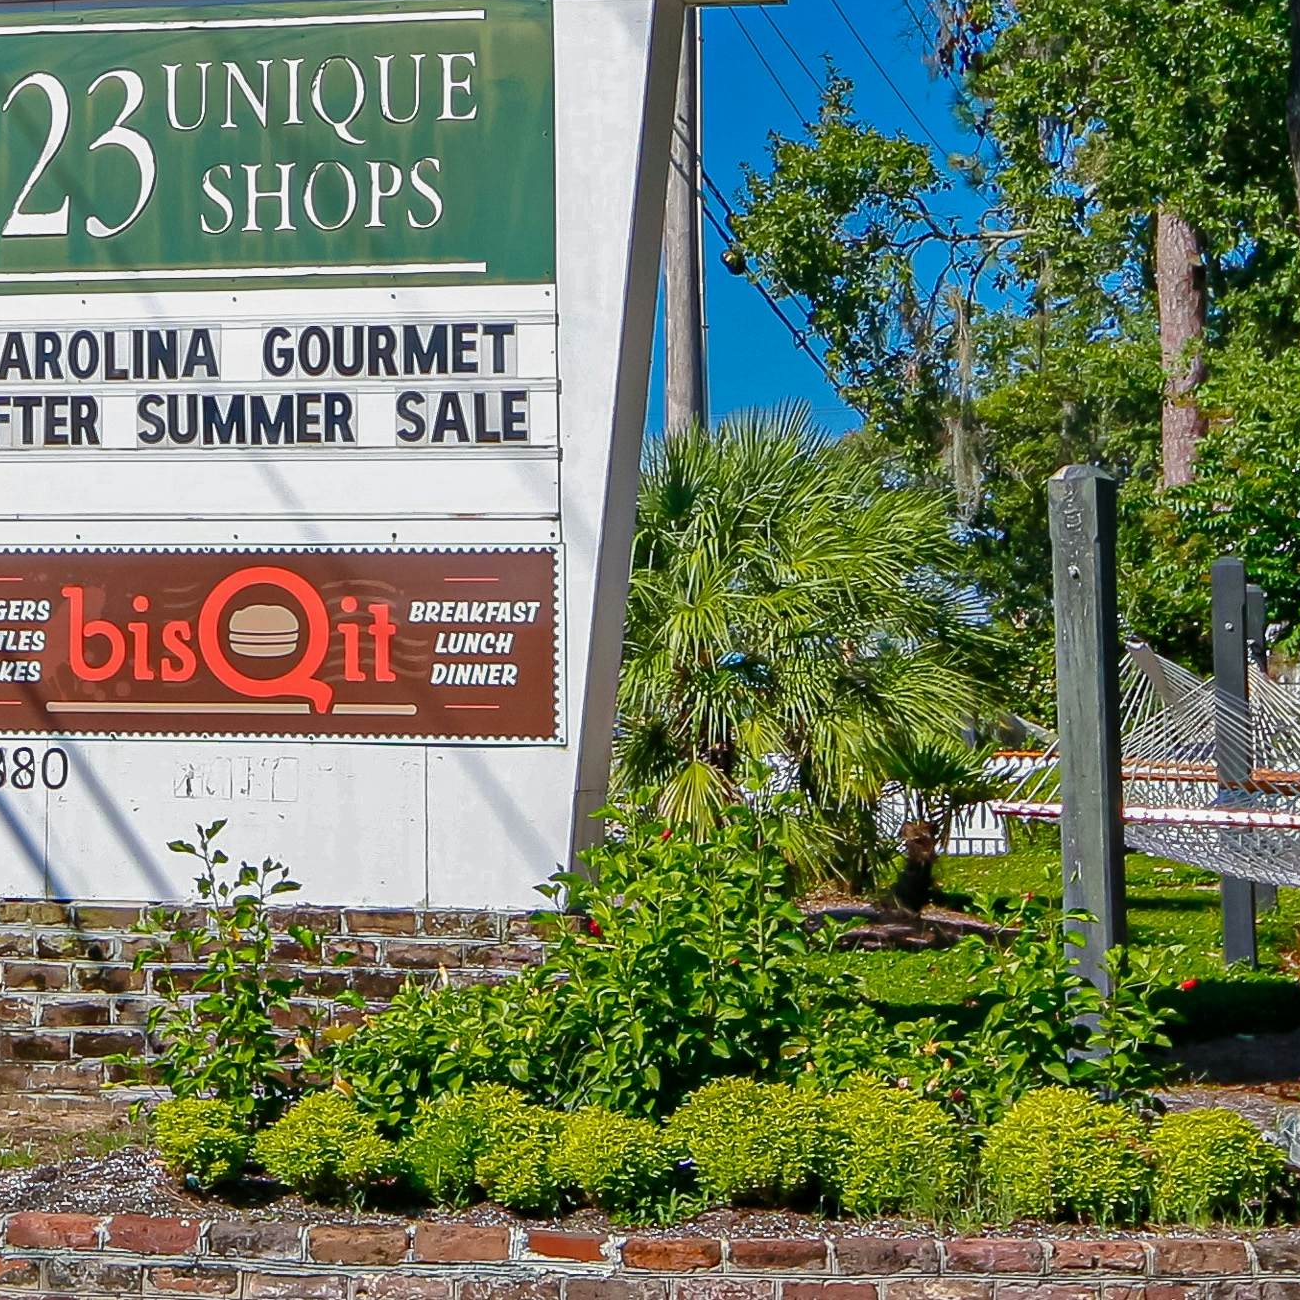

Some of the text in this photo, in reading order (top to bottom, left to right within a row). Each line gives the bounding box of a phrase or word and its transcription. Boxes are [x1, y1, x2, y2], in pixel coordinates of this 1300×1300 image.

[2, 51, 478, 238] 23 UNIQUE
[200, 157, 443, 235] SHOPS
[263, 323, 516, 378] GOURMET
[137, 391, 355, 445] SUMMER
[396, 389, 528, 443] SALE
[408, 600, 541, 625] BREAKFAST
[62, 566, 397, 715] bisQit
[434, 631, 513, 655] LUNCH
[430, 662, 518, 687] DINNER
